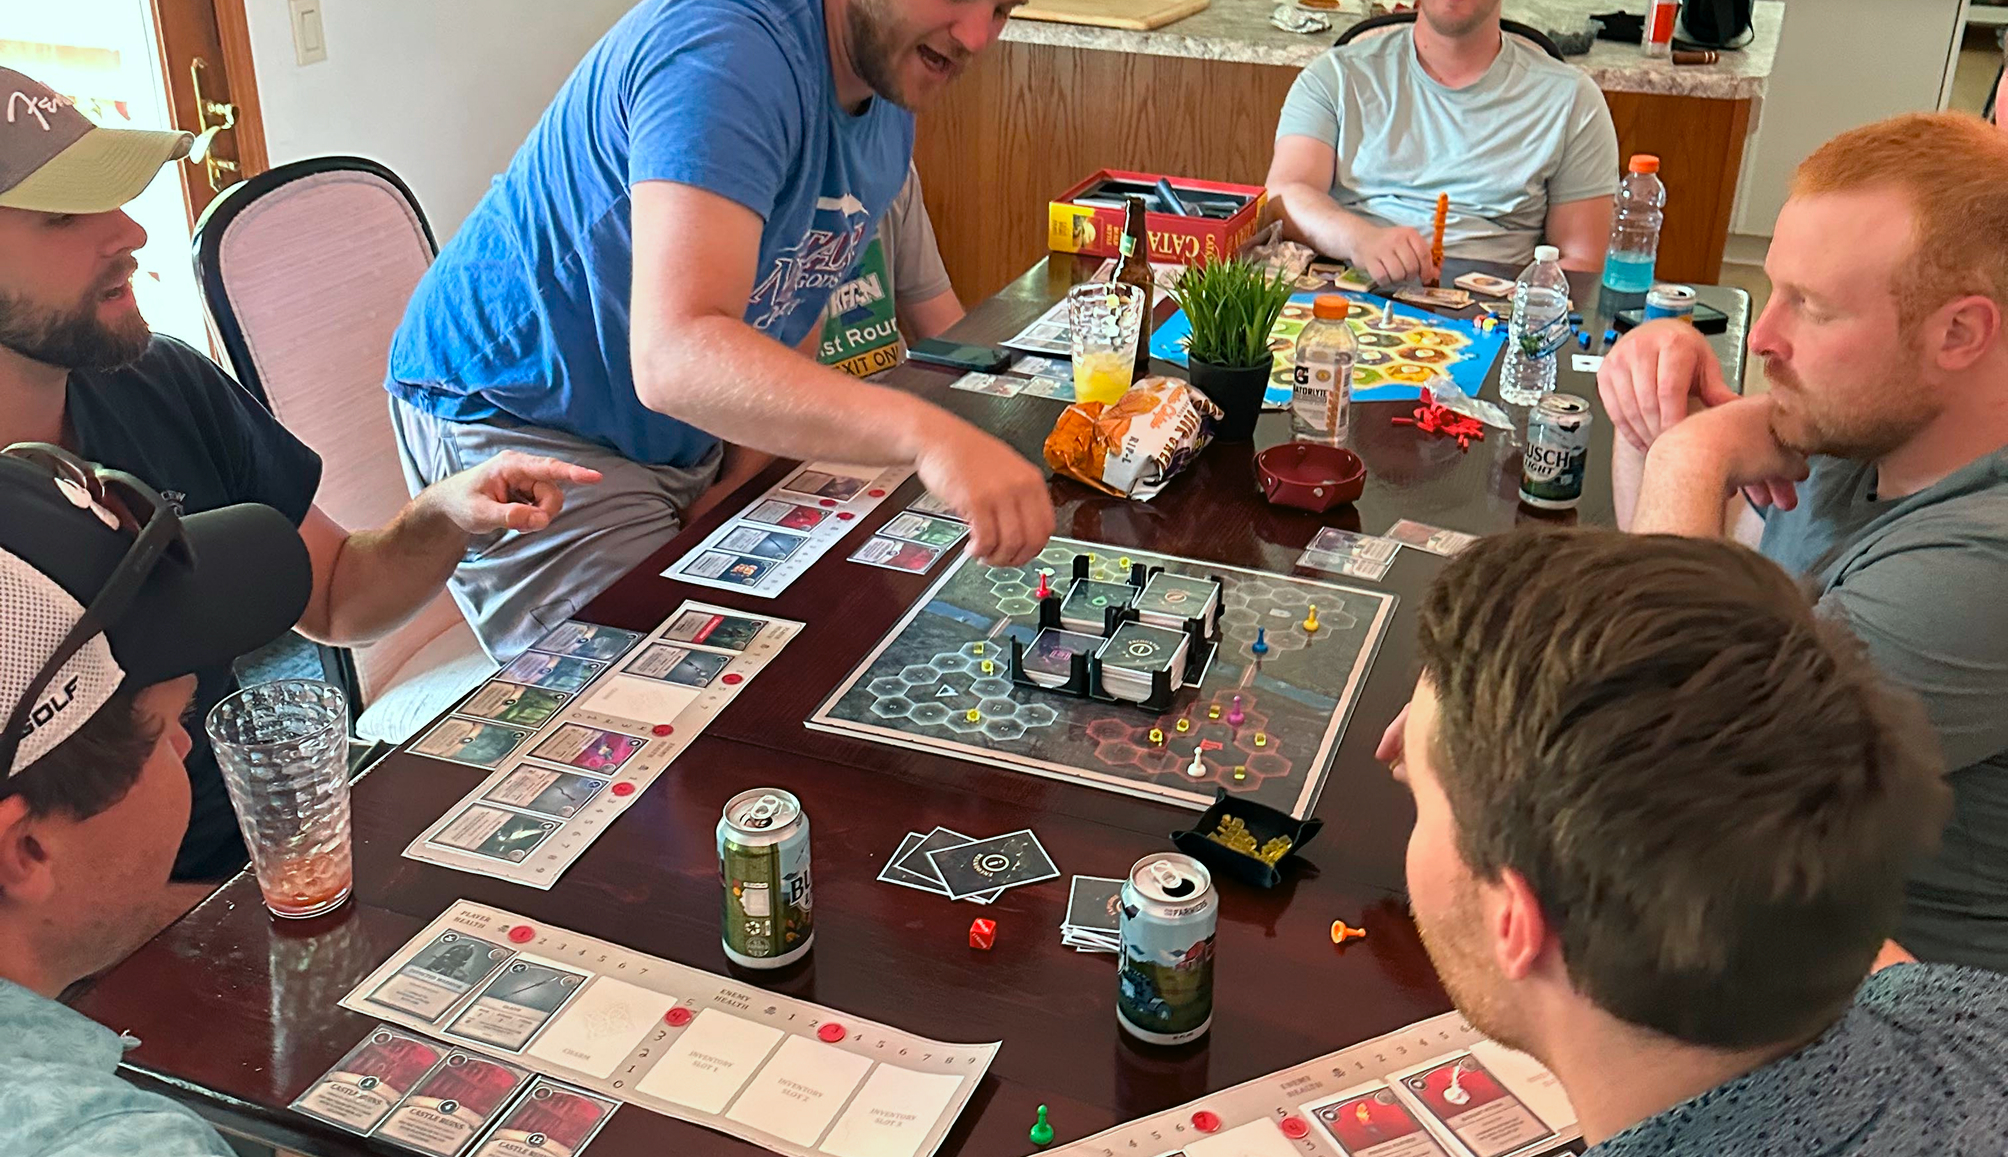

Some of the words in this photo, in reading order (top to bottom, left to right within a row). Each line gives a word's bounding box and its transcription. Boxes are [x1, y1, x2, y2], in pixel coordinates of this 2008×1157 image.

[1147, 231, 1200, 258] CATA
[845, 317, 897, 347] Rou
[835, 356, 868, 376] XIT
[873, 345, 899, 367] ON
[1526, 442, 1570, 468] USCH
[714, 995, 750, 1010] HEALTH
[720, 988, 752, 1001] ENEMY
